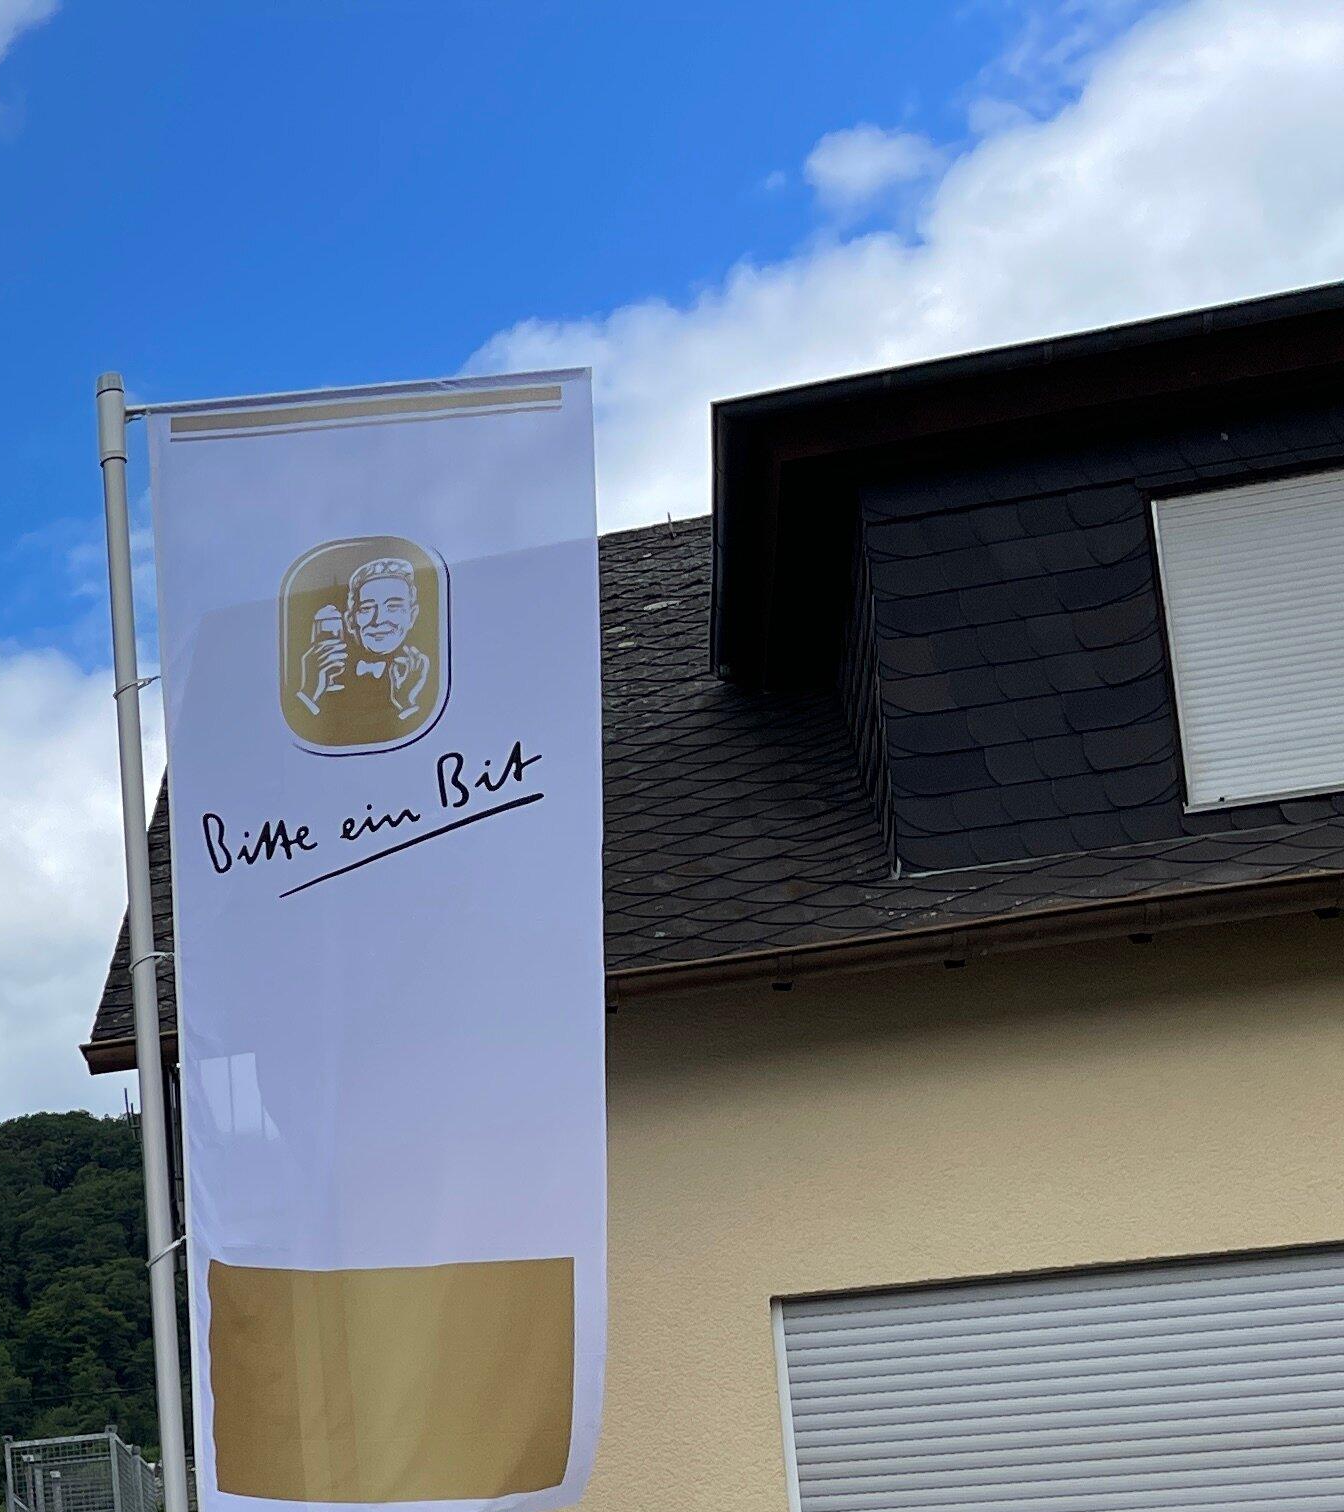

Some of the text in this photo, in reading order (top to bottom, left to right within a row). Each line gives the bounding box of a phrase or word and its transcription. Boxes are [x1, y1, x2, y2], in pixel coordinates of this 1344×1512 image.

[202, 741, 543, 874] Bitte ein Bit
